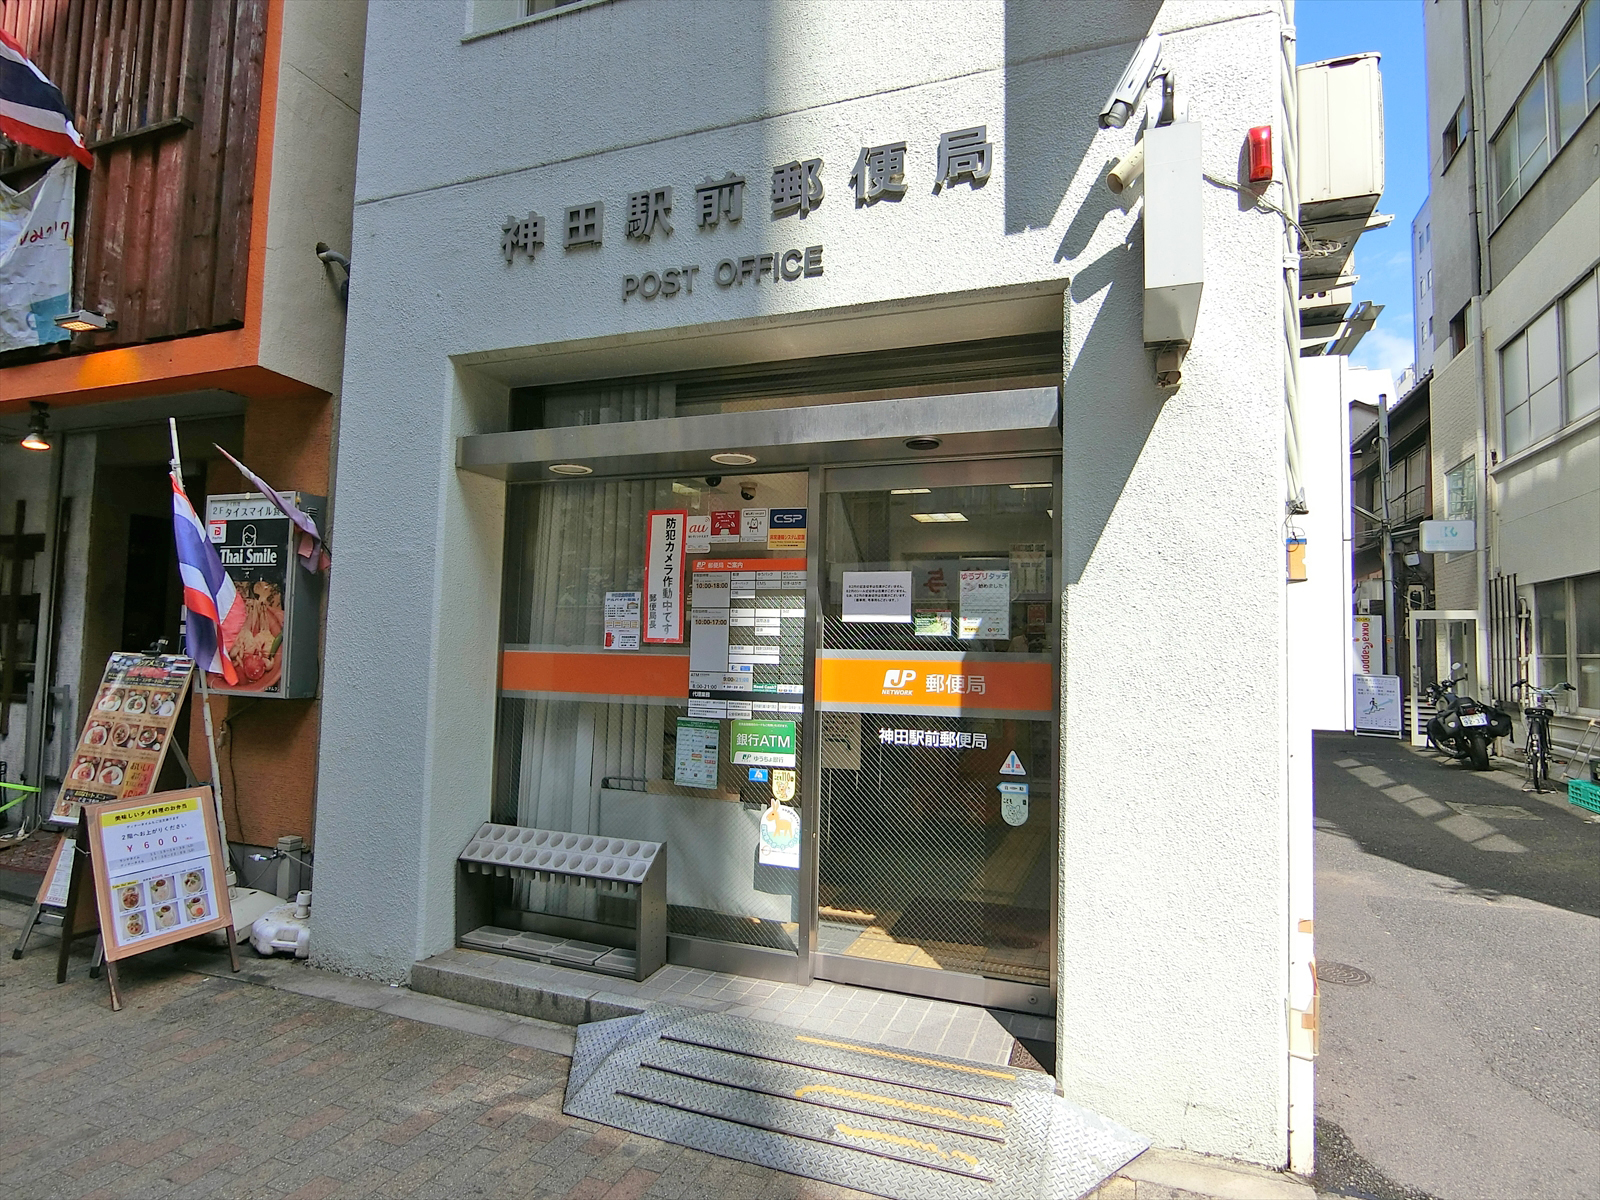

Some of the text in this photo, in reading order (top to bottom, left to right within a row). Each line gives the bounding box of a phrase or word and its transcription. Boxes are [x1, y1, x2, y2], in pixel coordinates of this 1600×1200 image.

[501, 125, 994, 263] 神田駅前郵便局
[622, 244, 825, 302] POST OFFICE
[225, 505, 286, 518] タイスマイル食
[773, 514, 803, 523] CSP
[689, 523, 709, 533] au
[220, 548, 278, 564] Thai Smile
[661, 517, 677, 635] 防犯カメラ作動中です
[648, 593, 657, 629] 郵便局長
[925, 673, 986, 695] 郵便局
[736, 733, 791, 748] 銀行ATM
[879, 728, 988, 749] 神田駅前郵便局
[115, 803, 188, 821] 美味しいタイ料理のお弁当
[121, 823, 187, 840] 2階へお上がりください
